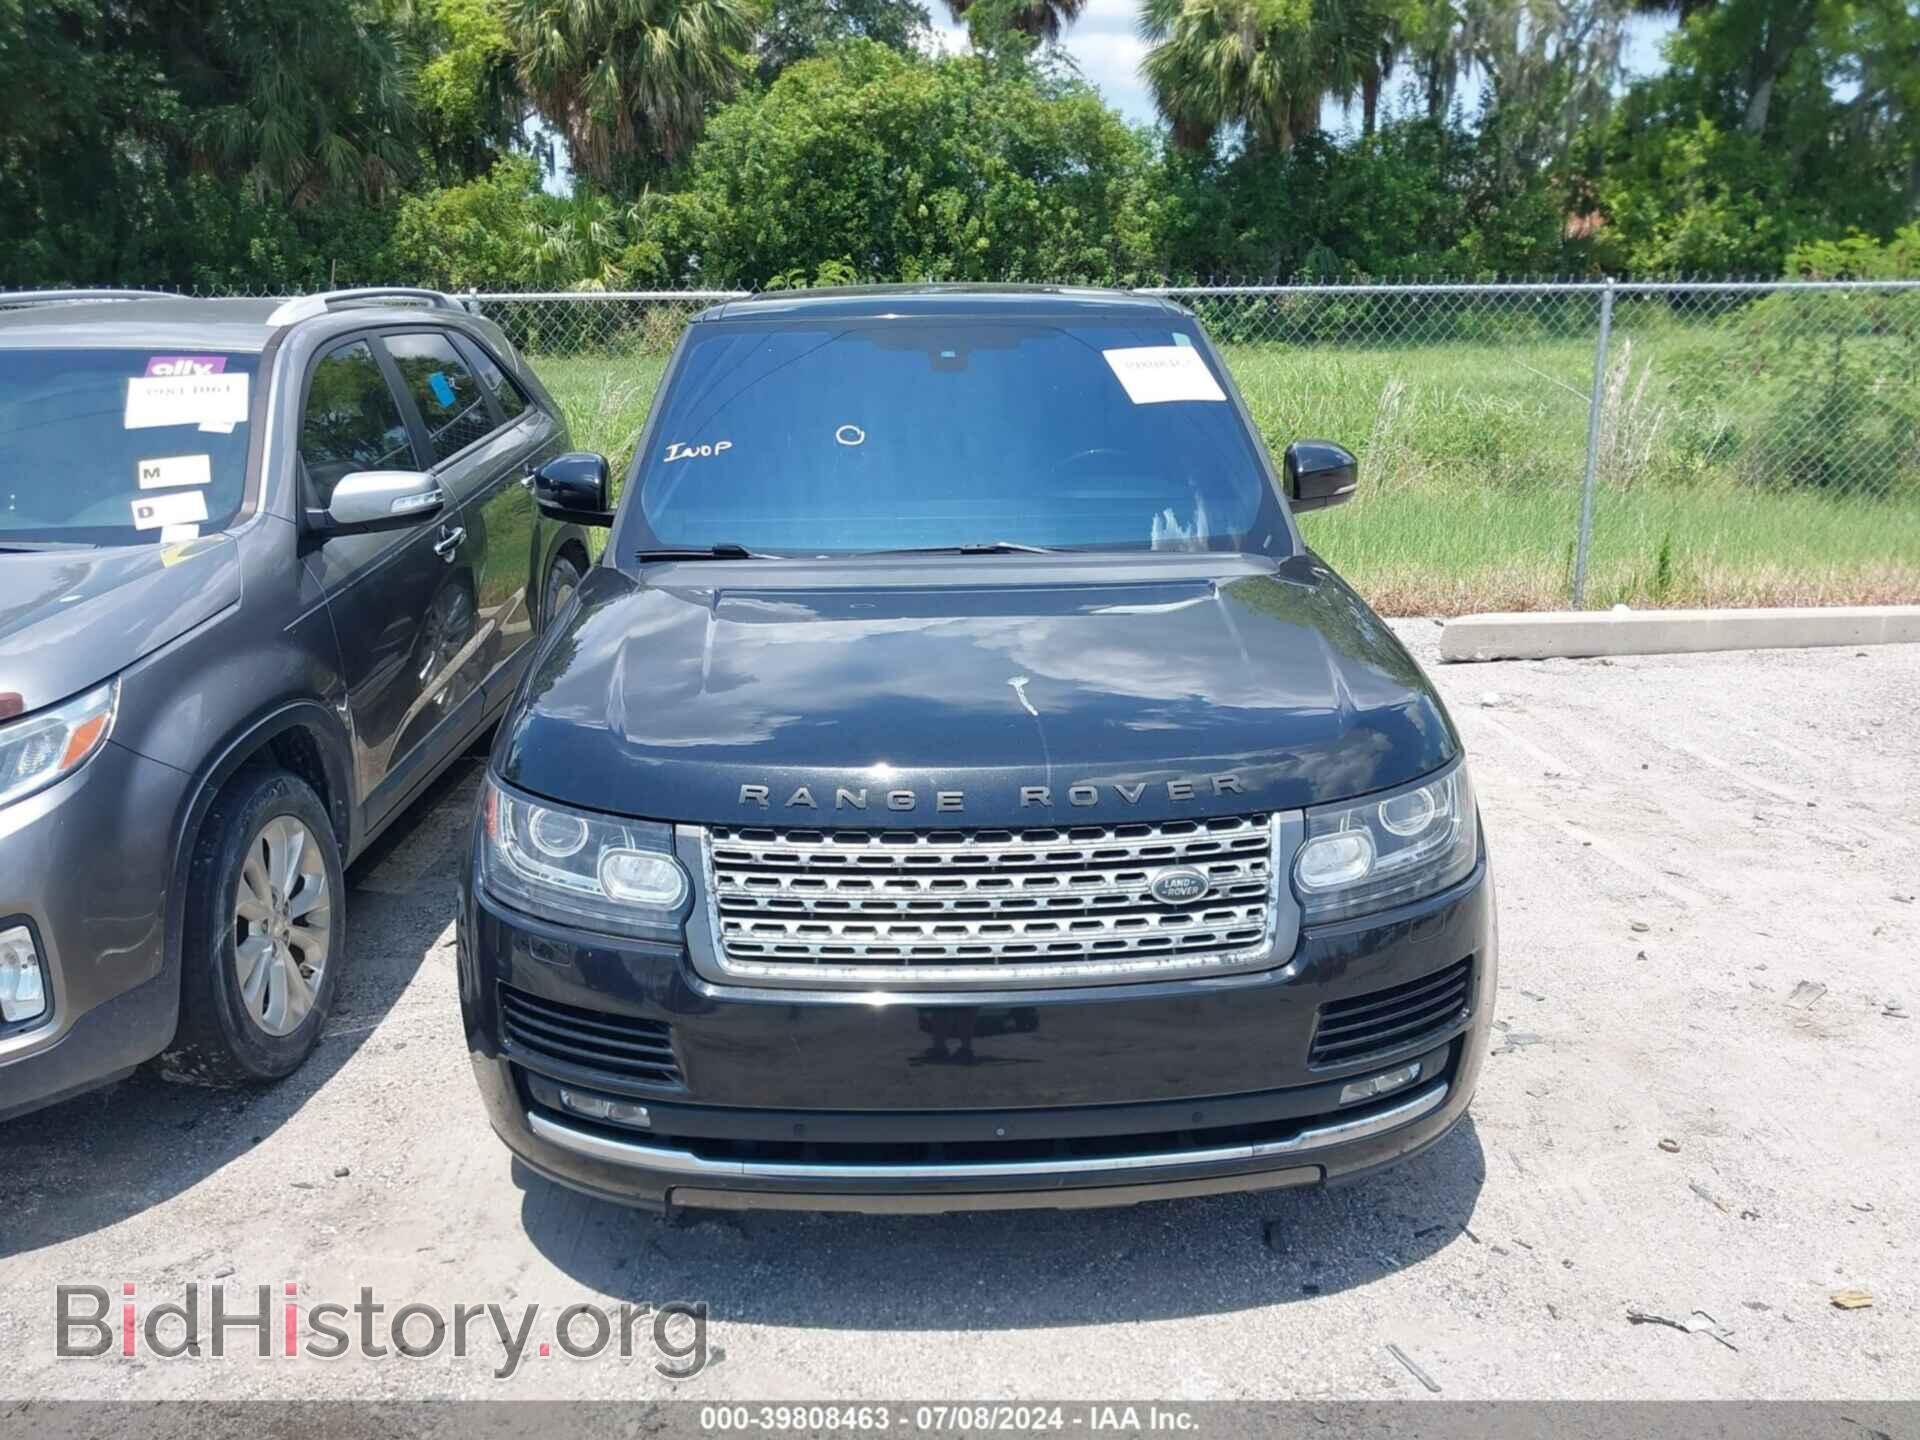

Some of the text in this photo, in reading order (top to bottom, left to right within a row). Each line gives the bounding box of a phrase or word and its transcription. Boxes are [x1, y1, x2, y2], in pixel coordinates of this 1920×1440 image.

[143, 467, 160, 479] M
[138, 506, 154, 519] D
[738, 774, 1246, 813] RANGE ROVER
